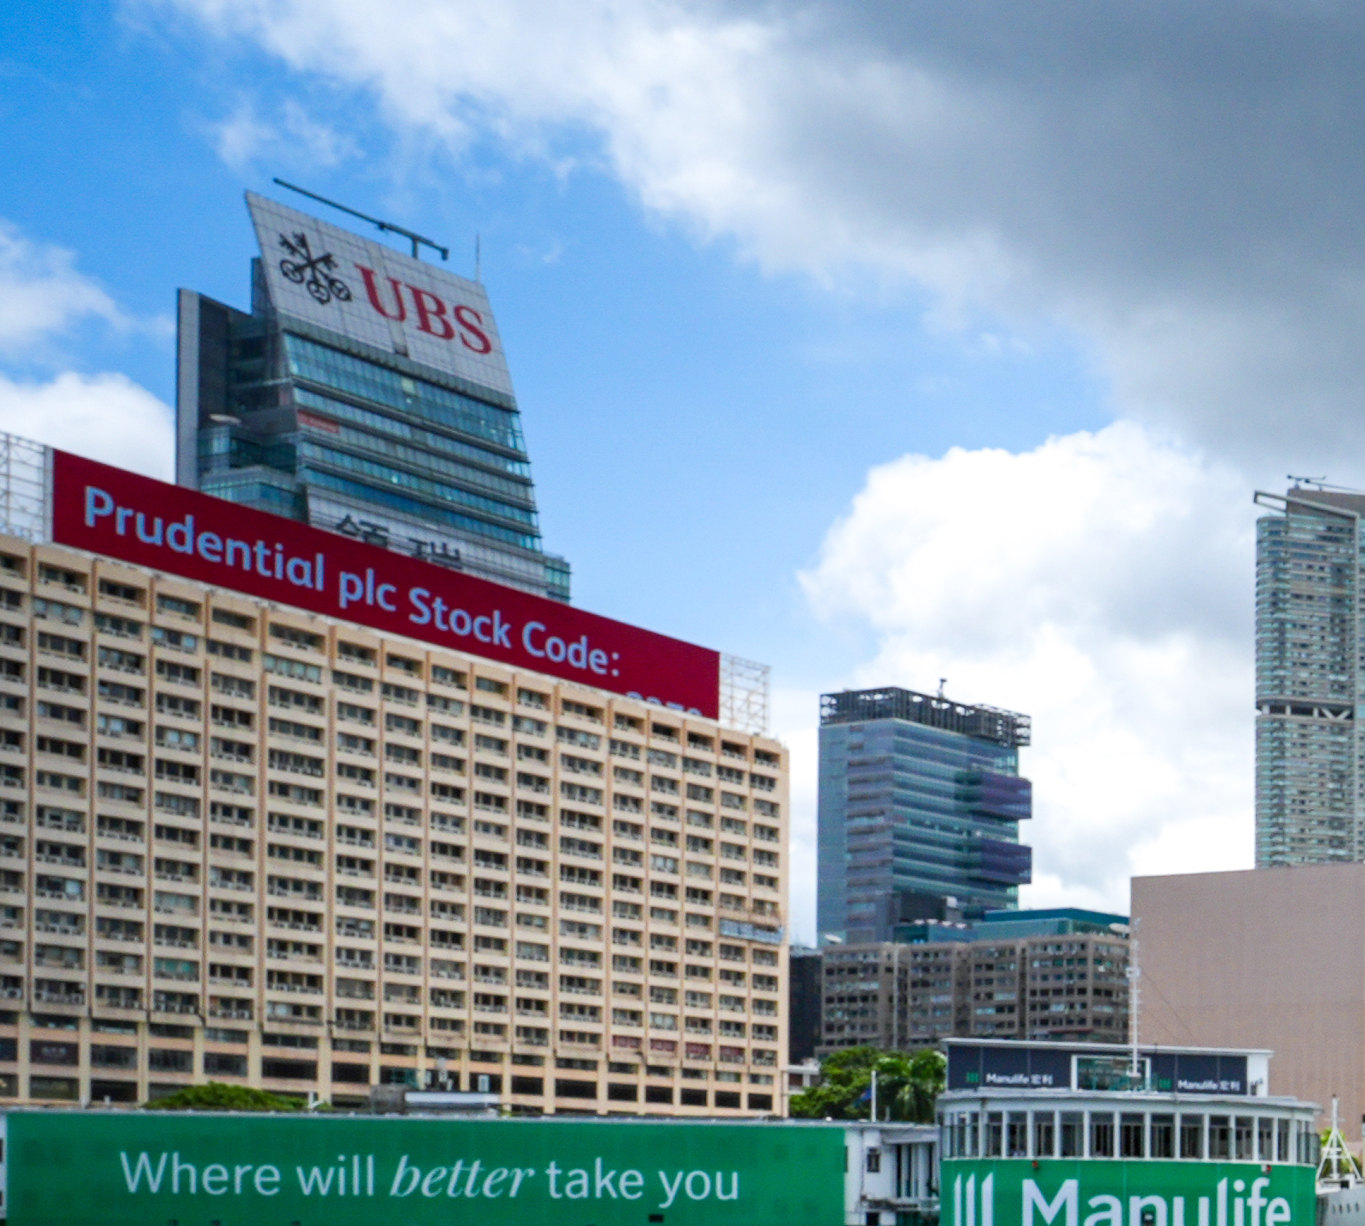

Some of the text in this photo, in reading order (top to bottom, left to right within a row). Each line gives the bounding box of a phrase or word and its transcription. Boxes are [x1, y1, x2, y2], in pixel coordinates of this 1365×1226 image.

[354, 263, 492, 355] UBS
[85, 485, 324, 591] Prudential
[339, 567, 397, 612] plc
[408, 587, 512, 649] Stock
[522, 620, 620, 677] Code:
[985, 1073, 1029, 1084] Manulife
[1177, 1079, 1218, 1090] Manulife
[120, 1151, 739, 1208] Where will better take you
